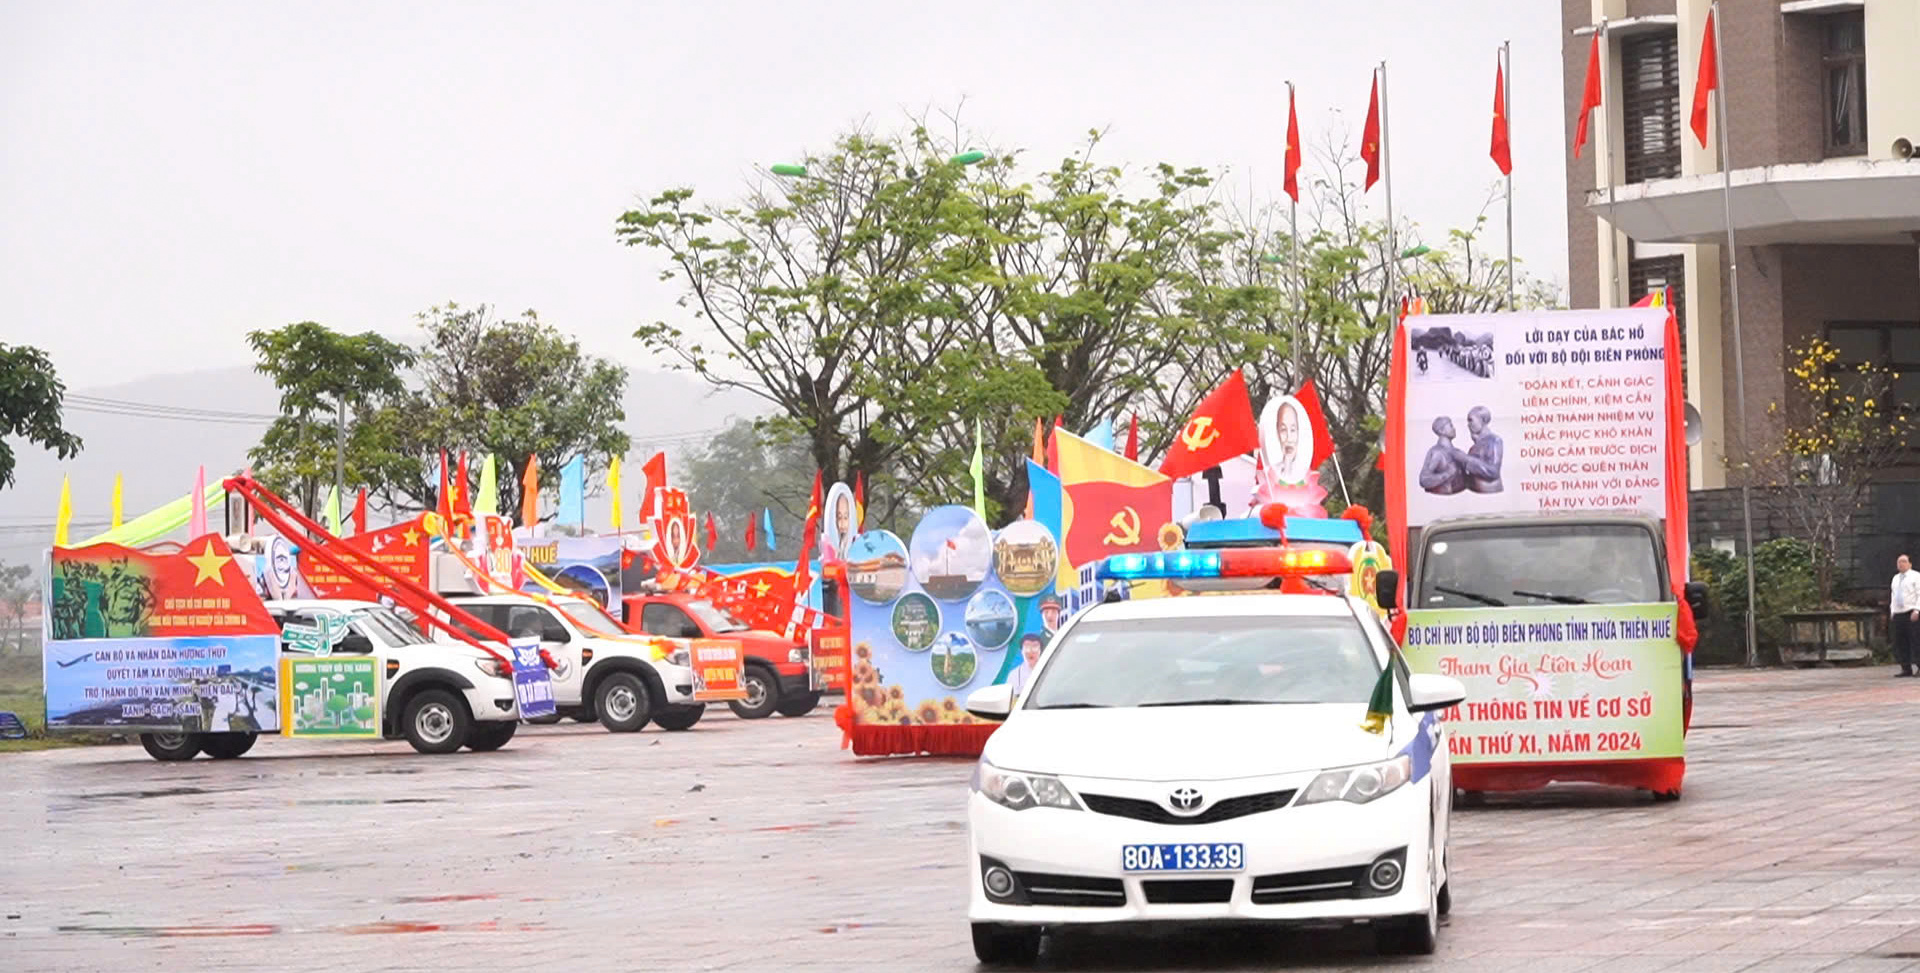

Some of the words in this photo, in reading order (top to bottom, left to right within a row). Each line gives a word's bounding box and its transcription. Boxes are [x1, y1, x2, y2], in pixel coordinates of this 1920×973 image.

[1525, 328, 1543, 344] LỜI
[1548, 329, 1570, 345] DẠY
[1574, 325, 1598, 342] CỦA
[1601, 326, 1625, 341] BÁC
[1505, 349, 1525, 365] ĐỐI
[1529, 349, 1547, 364] VỚI
[1552, 349, 1567, 366] BỘ
[1571, 348, 1591, 366] ĐỘI
[1594, 346, 1622, 362] BIÊN
[1625, 345, 1665, 361] PHÒNG
[1587, 374, 1620, 388] CẢNH
[1624, 374, 1655, 387] GIÁC
[1522, 395, 1549, 407] LIÊM
[1594, 394, 1622, 406] KIỆM
[1521, 413, 1553, 424] HOÀN
[1556, 411, 1594, 423] THÀNH
[1597, 411, 1635, 422] NHIỆM
[1638, 411, 1654, 421] VỤ
[1524, 427, 1556, 441] KHẮC
[1559, 429, 1590, 441] PHỤC
[1520, 446, 1554, 458] DŨNG
[1589, 443, 1626, 456] TRƯỚC
[1630, 444, 1657, 455] ĐỊCH
[1530, 463, 1541, 474] VÌ
[1544, 462, 1578, 474] NƯỚC
[1582, 460, 1616, 472] QUÊN
[1619, 460, 1649, 471] THÂN
[1520, 481, 1558, 492] TRUNG
[1561, 479, 1598, 490] THÀNH
[1601, 478, 1621, 489] VỚI
[1625, 476, 1660, 488] ĐẢNG
[1589, 495, 1609, 507] VỚI
[531, 540, 558, 564] HUẾ
[1408, 623, 1421, 649] BỘ
[1424, 620, 1441, 645] CHỈ
[1444, 625, 1463, 645] HUY
[1466, 621, 1480, 648] BỘ
[1482, 621, 1499, 648] ĐỘI
[1502, 620, 1526, 643] BIÊN
[1529, 618, 1563, 642] PHÒNG
[1566, 616, 1588, 641] TỈNH
[1591, 617, 1617, 640] THỪA
[1620, 616, 1649, 639] THIÊN
[1652, 614, 1671, 639] HUẾ
[137, 648, 159, 661] NHÂN
[1439, 656, 1492, 676] Tham
[1497, 654, 1539, 692] Gia
[1536, 653, 1577, 674] Liên
[1582, 648, 1632, 680] Hoan
[172, 686, 193, 697] MINH
[122, 704, 145, 717] XANH
[1467, 698, 1527, 721] THÔNG
[1533, 700, 1562, 719] TIN
[1597, 696, 1621, 718] CƠ
[1627, 690, 1652, 717] SỞ
[1477, 731, 1514, 754] THỨ
[1519, 734, 1542, 756] XI,
[1548, 729, 1591, 753] NĂM
[1597, 731, 1642, 751] 2024
[1125, 845, 1241, 869] 80A-133.39
